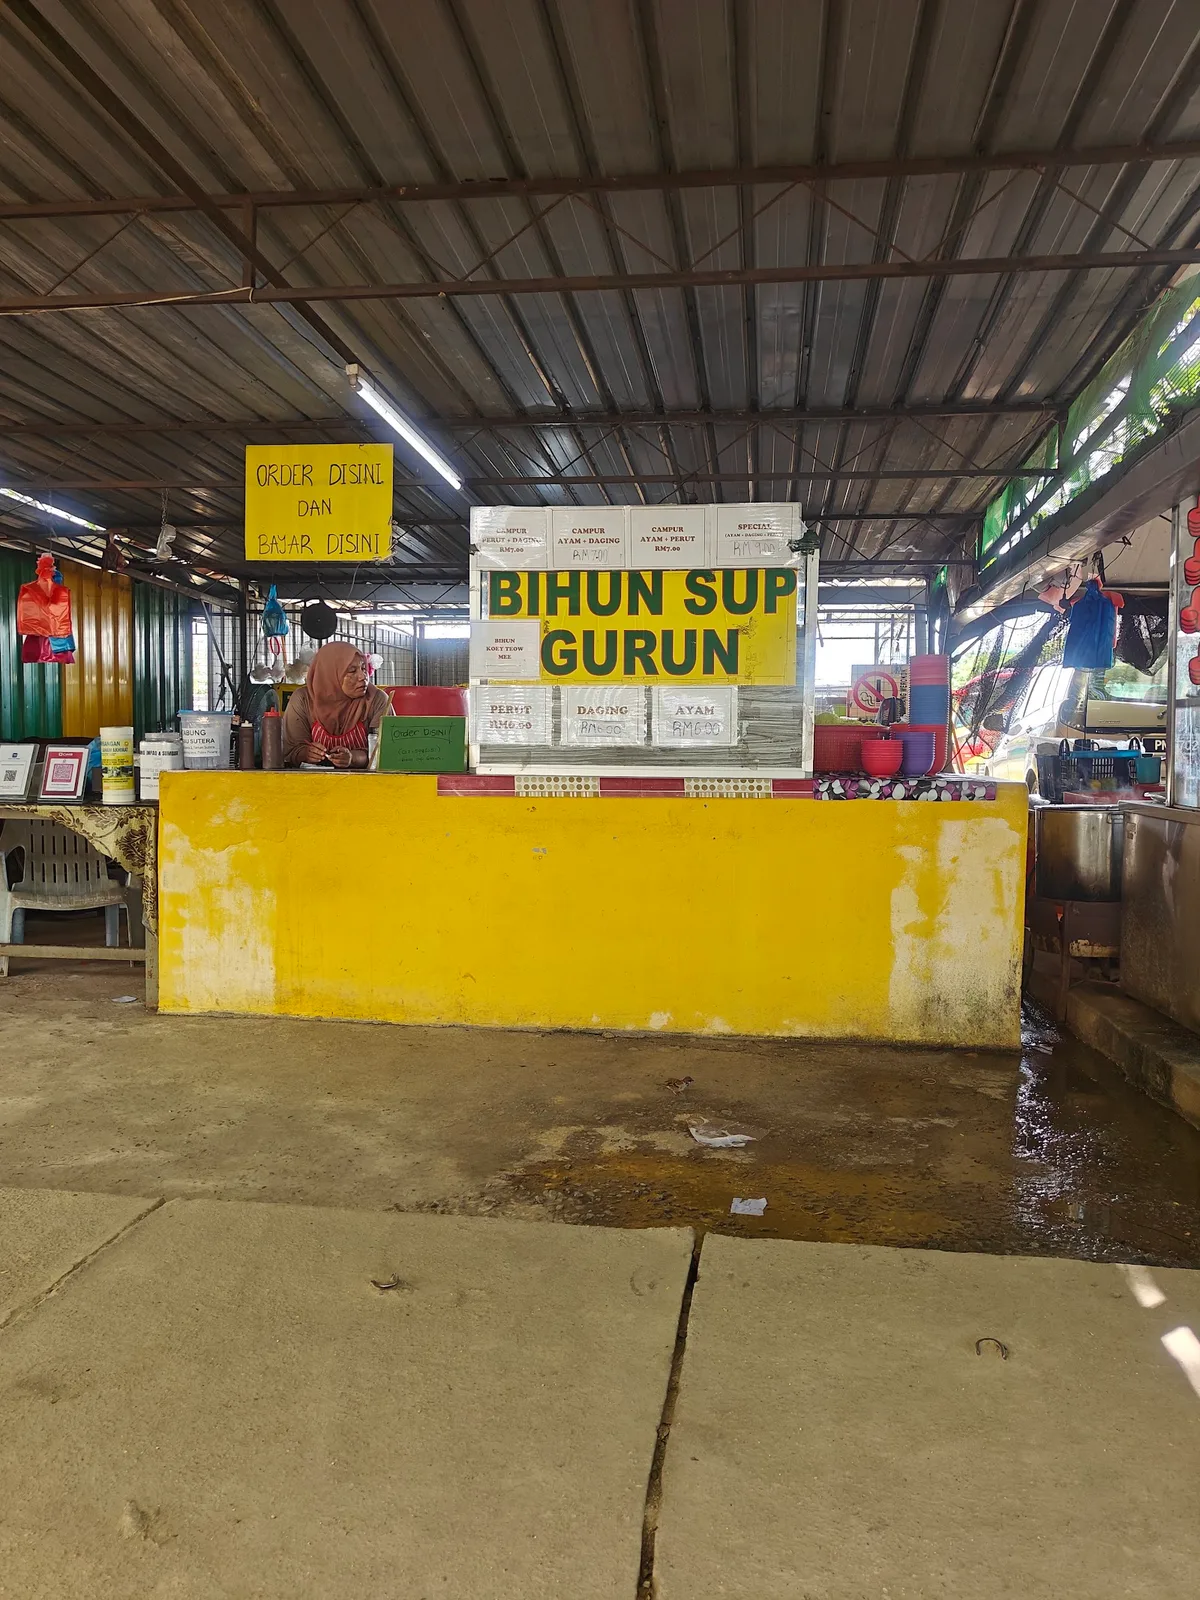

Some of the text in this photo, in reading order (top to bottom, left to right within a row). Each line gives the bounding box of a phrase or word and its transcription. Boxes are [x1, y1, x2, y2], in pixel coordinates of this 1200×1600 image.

[256, 464, 313, 487] ORDER
[298, 498, 332, 517] DAN
[258, 533, 380, 554] BAYAR DISINI
[489, 568, 797, 616] BIHUN SUP
[540, 628, 739, 676] GURUN
[490, 705, 532, 714] PERUT
[577, 705, 629, 715] DAGING
[675, 705, 715, 715] AYAM
[393, 729, 419, 738] Order
